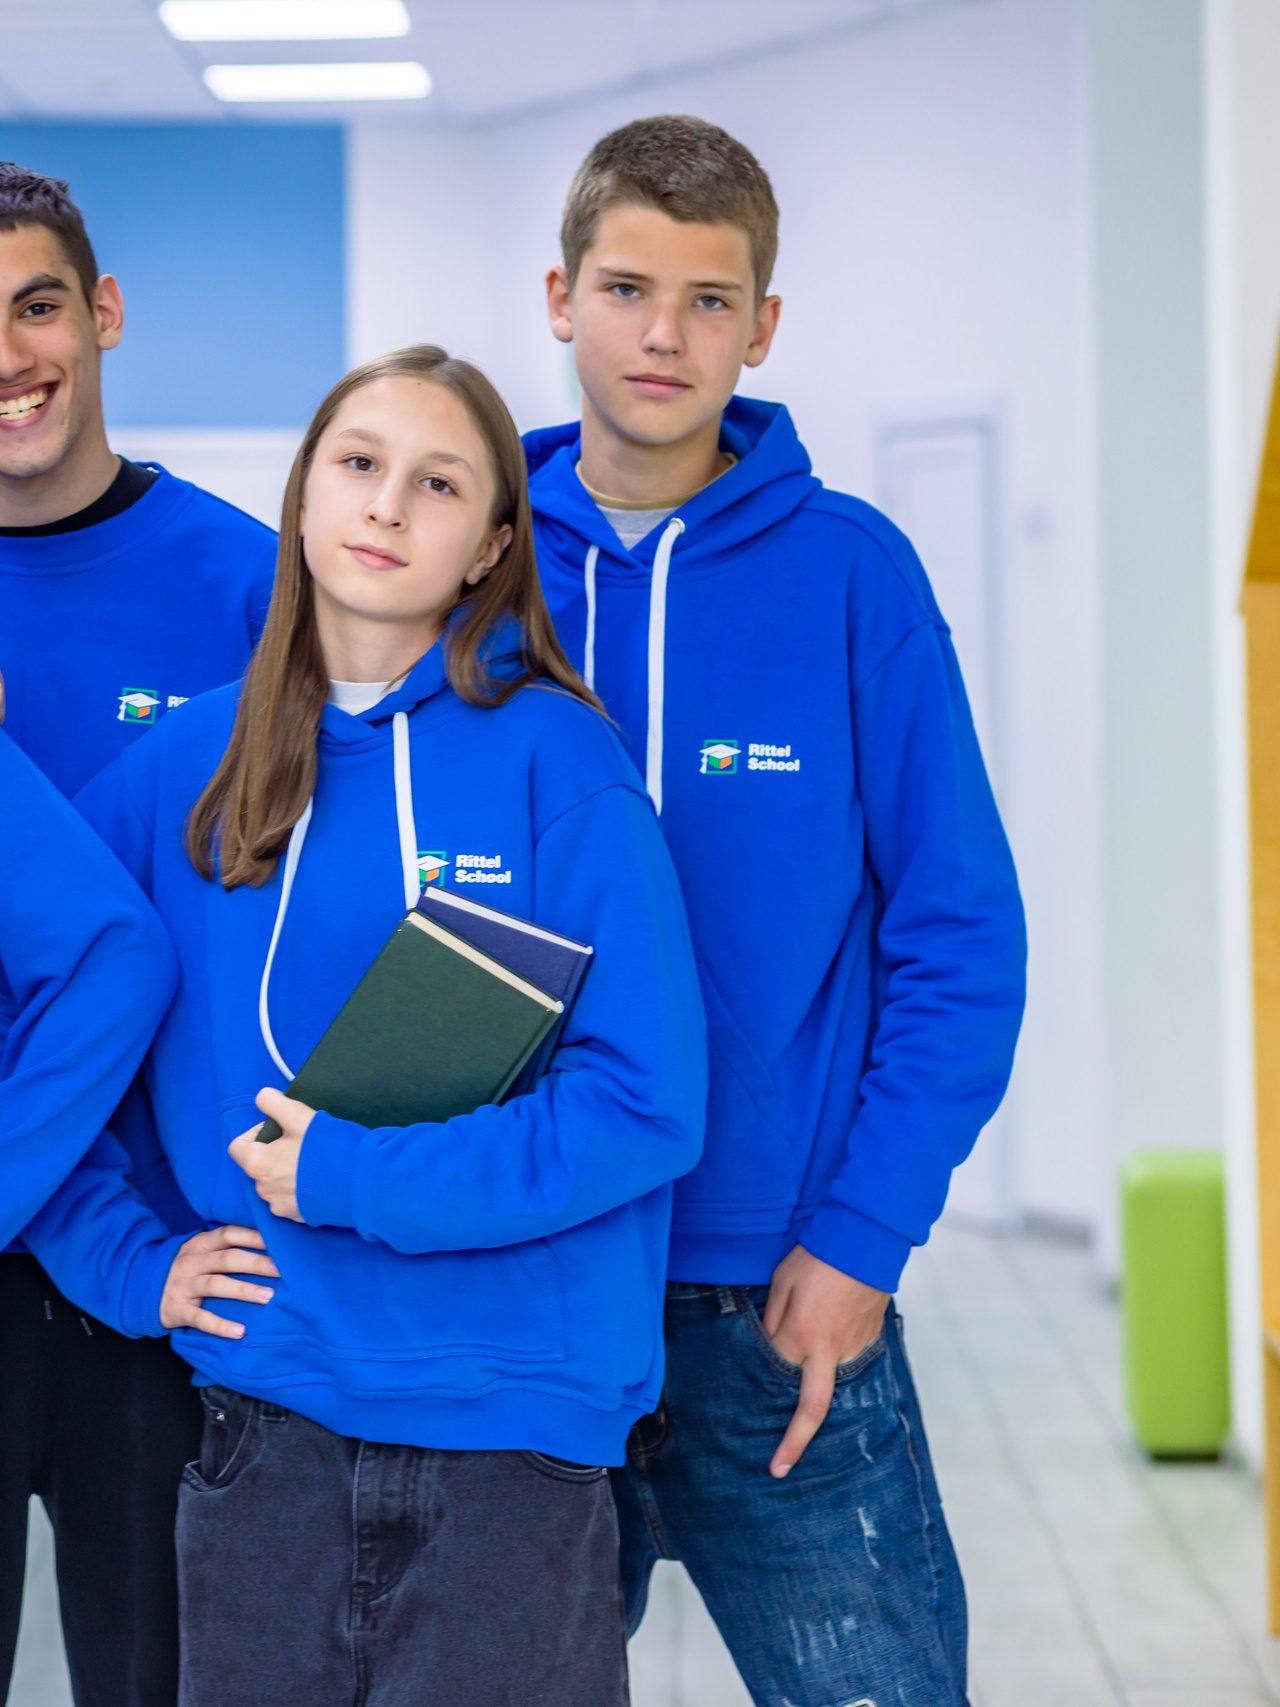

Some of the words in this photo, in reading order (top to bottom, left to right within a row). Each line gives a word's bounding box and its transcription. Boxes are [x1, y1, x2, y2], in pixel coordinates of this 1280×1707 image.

[748, 743, 791, 757] Rittel
[748, 757, 800, 771] School
[456, 855, 501, 868] Rittel
[455, 869, 511, 884] School
